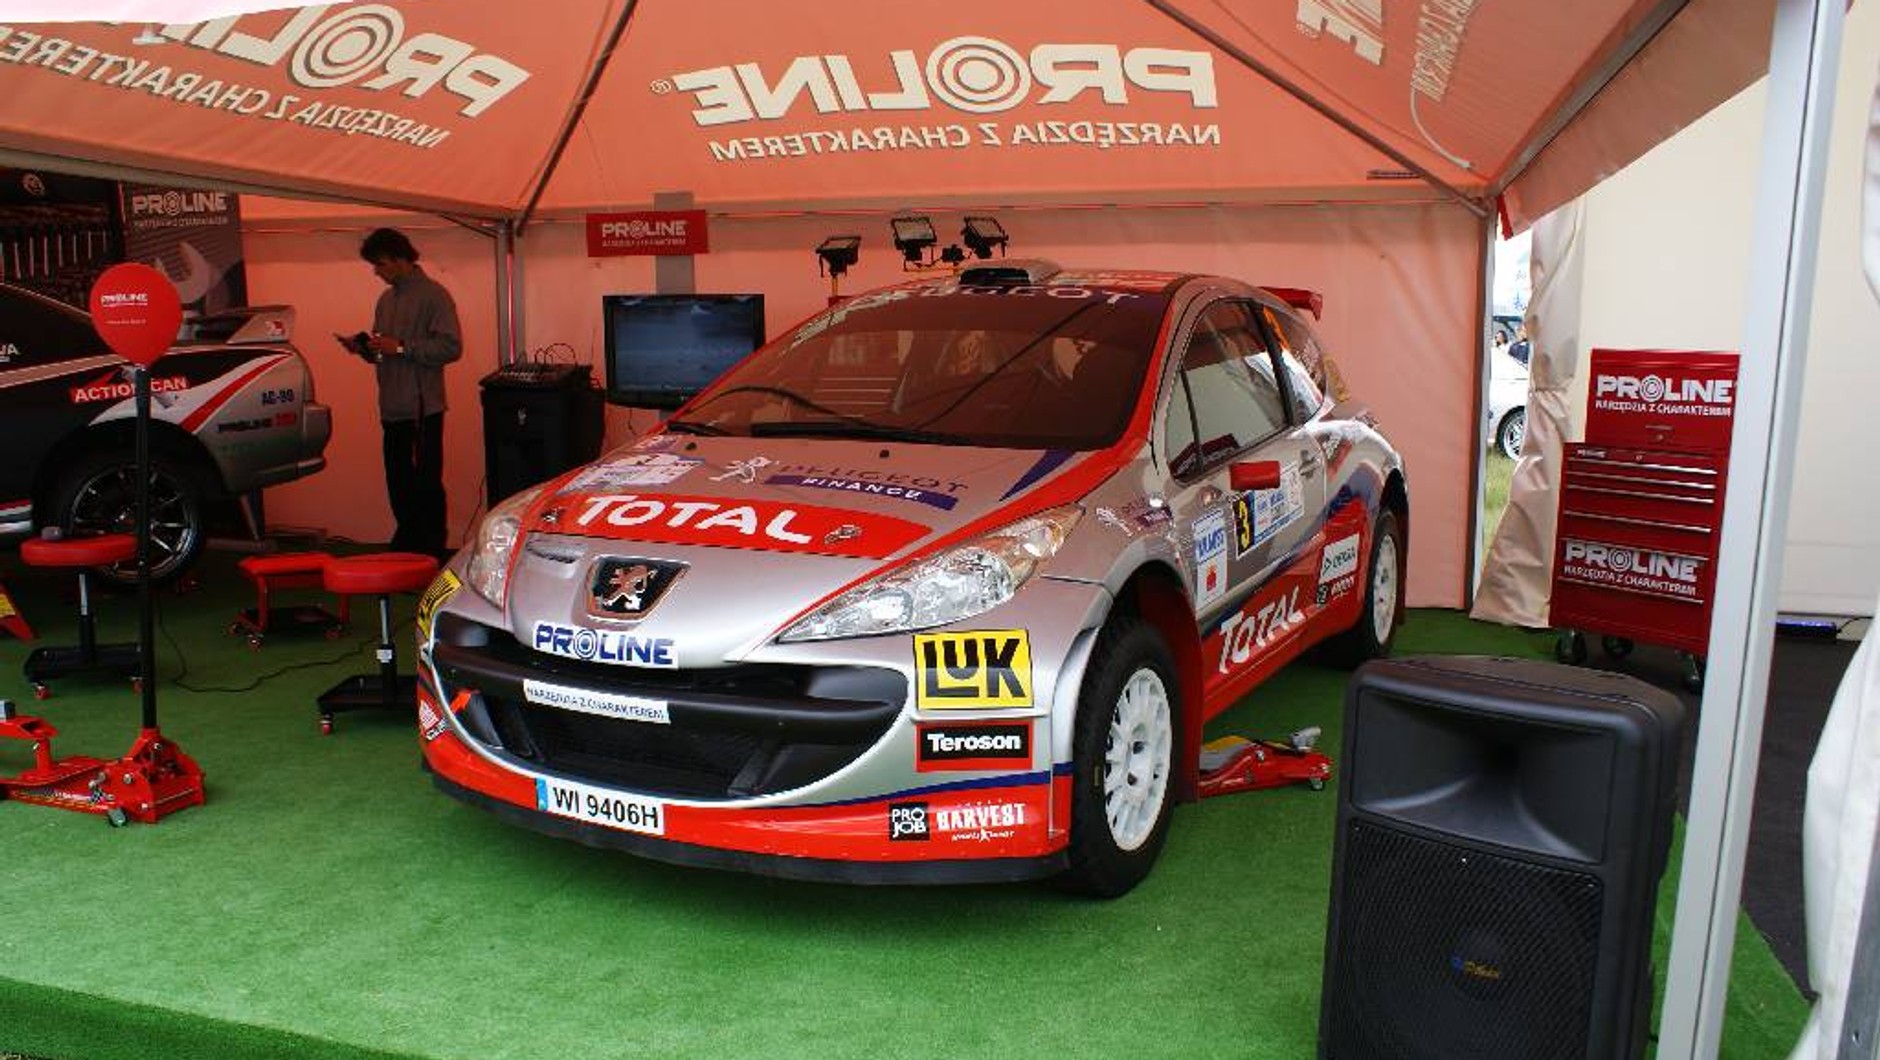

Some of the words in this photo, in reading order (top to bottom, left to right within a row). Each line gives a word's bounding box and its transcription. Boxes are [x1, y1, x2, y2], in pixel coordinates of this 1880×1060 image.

[131, 190, 228, 216] PROLINE
[601, 219, 688, 240] PROLINE
[73, 384, 136, 403] ACTIO
[1595, 374, 1734, 404] PROLINE
[576, 494, 813, 545] TOTAL
[1239, 499, 1251, 550] 3
[1565, 540, 1700, 583] PROLINE
[535, 622, 676, 666] PROLINE
[1218, 584, 1307, 675] TOTAL
[926, 732, 1022, 753] Teroson
[552, 786, 580, 814] WI
[586, 793, 659, 829] 9406H
[891, 807, 925, 823] PRO
[935, 802, 1026, 832] HARVEST
[891, 821, 927, 839] JOB
